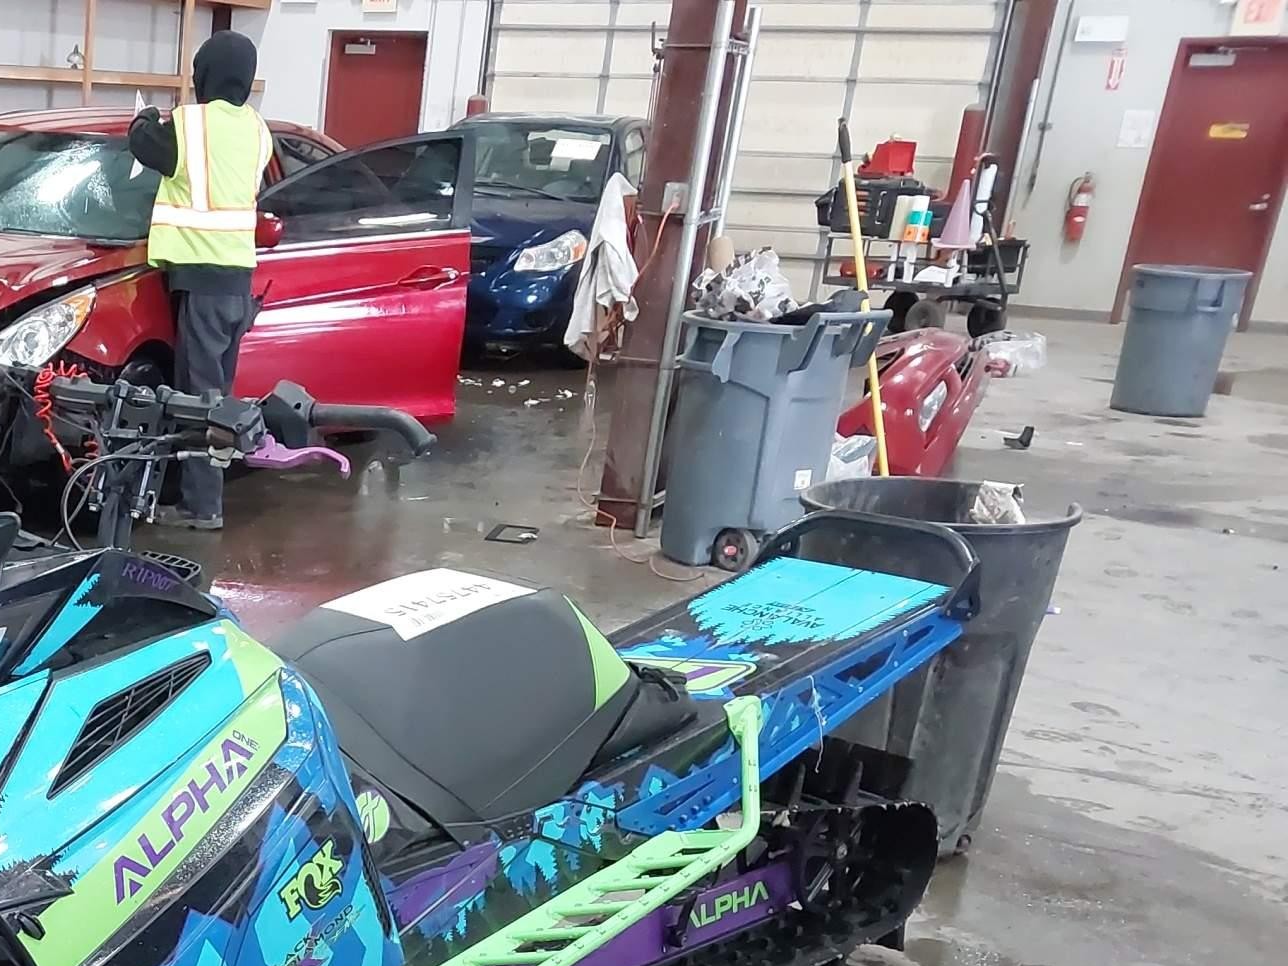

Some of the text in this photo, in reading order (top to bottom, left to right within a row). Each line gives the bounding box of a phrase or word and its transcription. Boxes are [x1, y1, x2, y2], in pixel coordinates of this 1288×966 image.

[383, 582, 492, 617] 44757415
[722, 603, 825, 629] AVALANCHE
[232, 729, 259, 752] ONE
[113, 738, 255, 906] ALPHA
[277, 836, 344, 923] FOX
